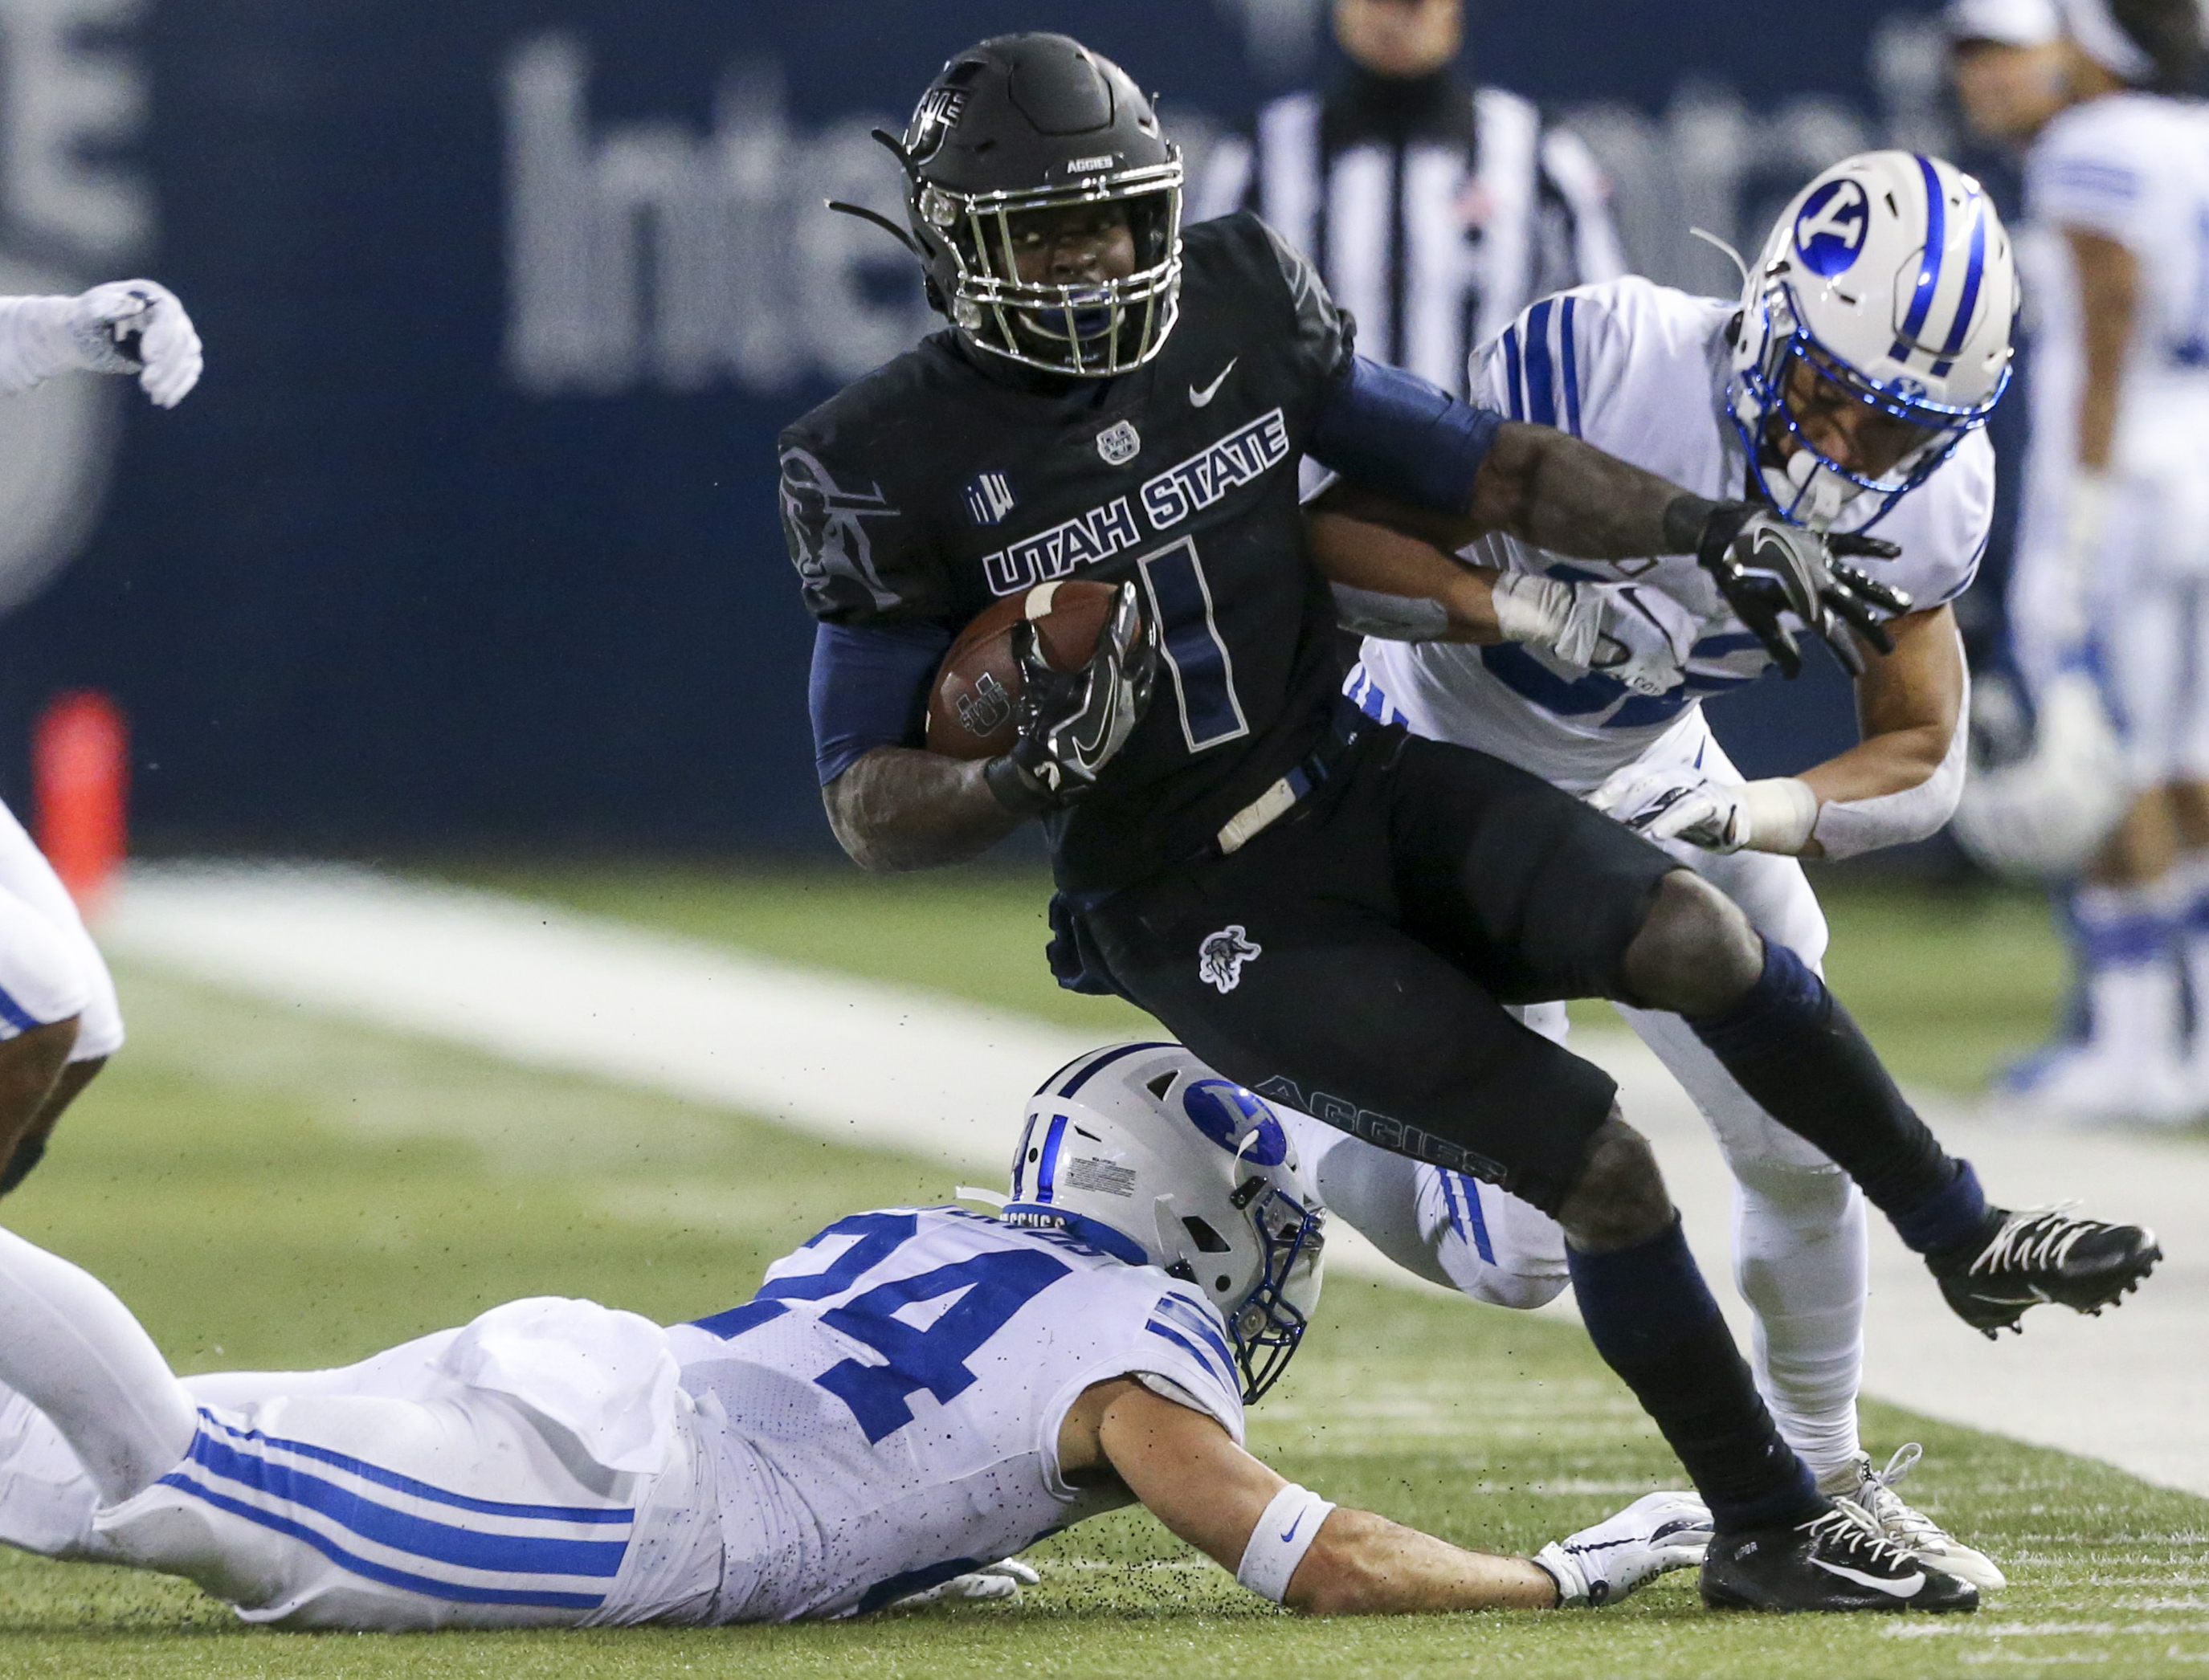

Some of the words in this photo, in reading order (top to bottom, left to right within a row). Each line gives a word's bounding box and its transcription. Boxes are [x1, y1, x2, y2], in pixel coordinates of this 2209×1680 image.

[1067, 155, 1113, 174] AGGIES
[982, 495, 1141, 597] UTAH
[1140, 407, 1289, 530] STATE
[1137, 534, 1250, 753] 1
[1253, 1074, 1509, 1184] AGGIES
[690, 1211, 1074, 1445] 24
